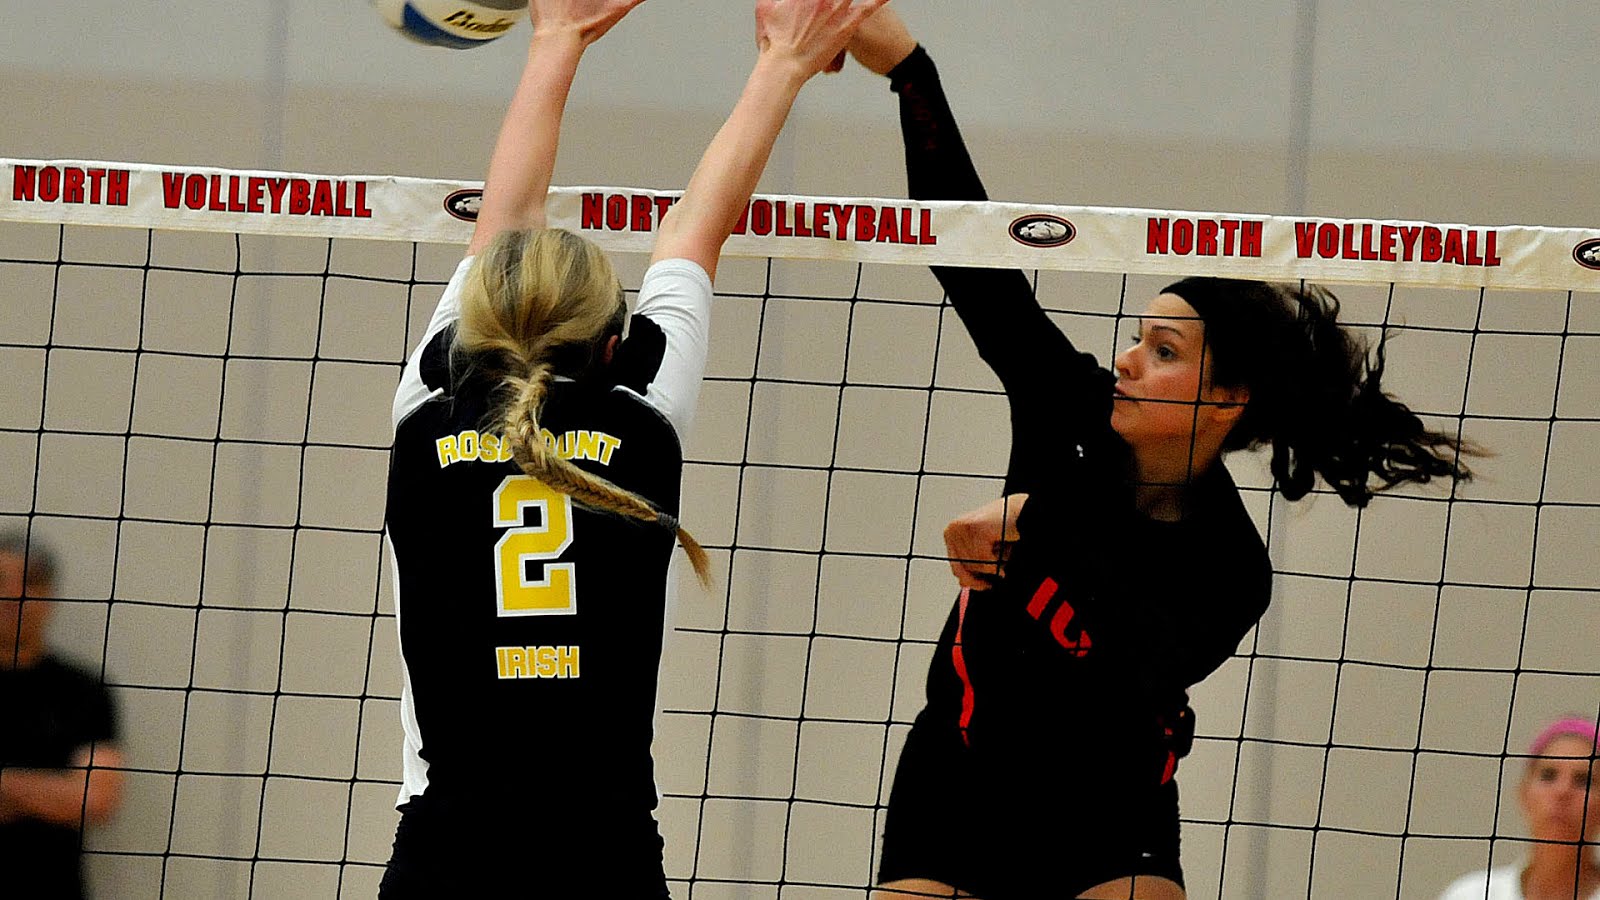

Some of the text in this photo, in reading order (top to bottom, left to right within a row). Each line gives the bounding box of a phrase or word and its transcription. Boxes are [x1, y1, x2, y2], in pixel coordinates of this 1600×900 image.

[13, 164, 372, 218] NORTH VOLLEYBALL
[581, 193, 682, 232] NORT
[1146, 217, 1501, 267] NORTH VOLLEYBALL
[436, 429, 622, 468] ROSOUNT
[493, 475, 577, 617] 2
[496, 646, 580, 679] IRISH
